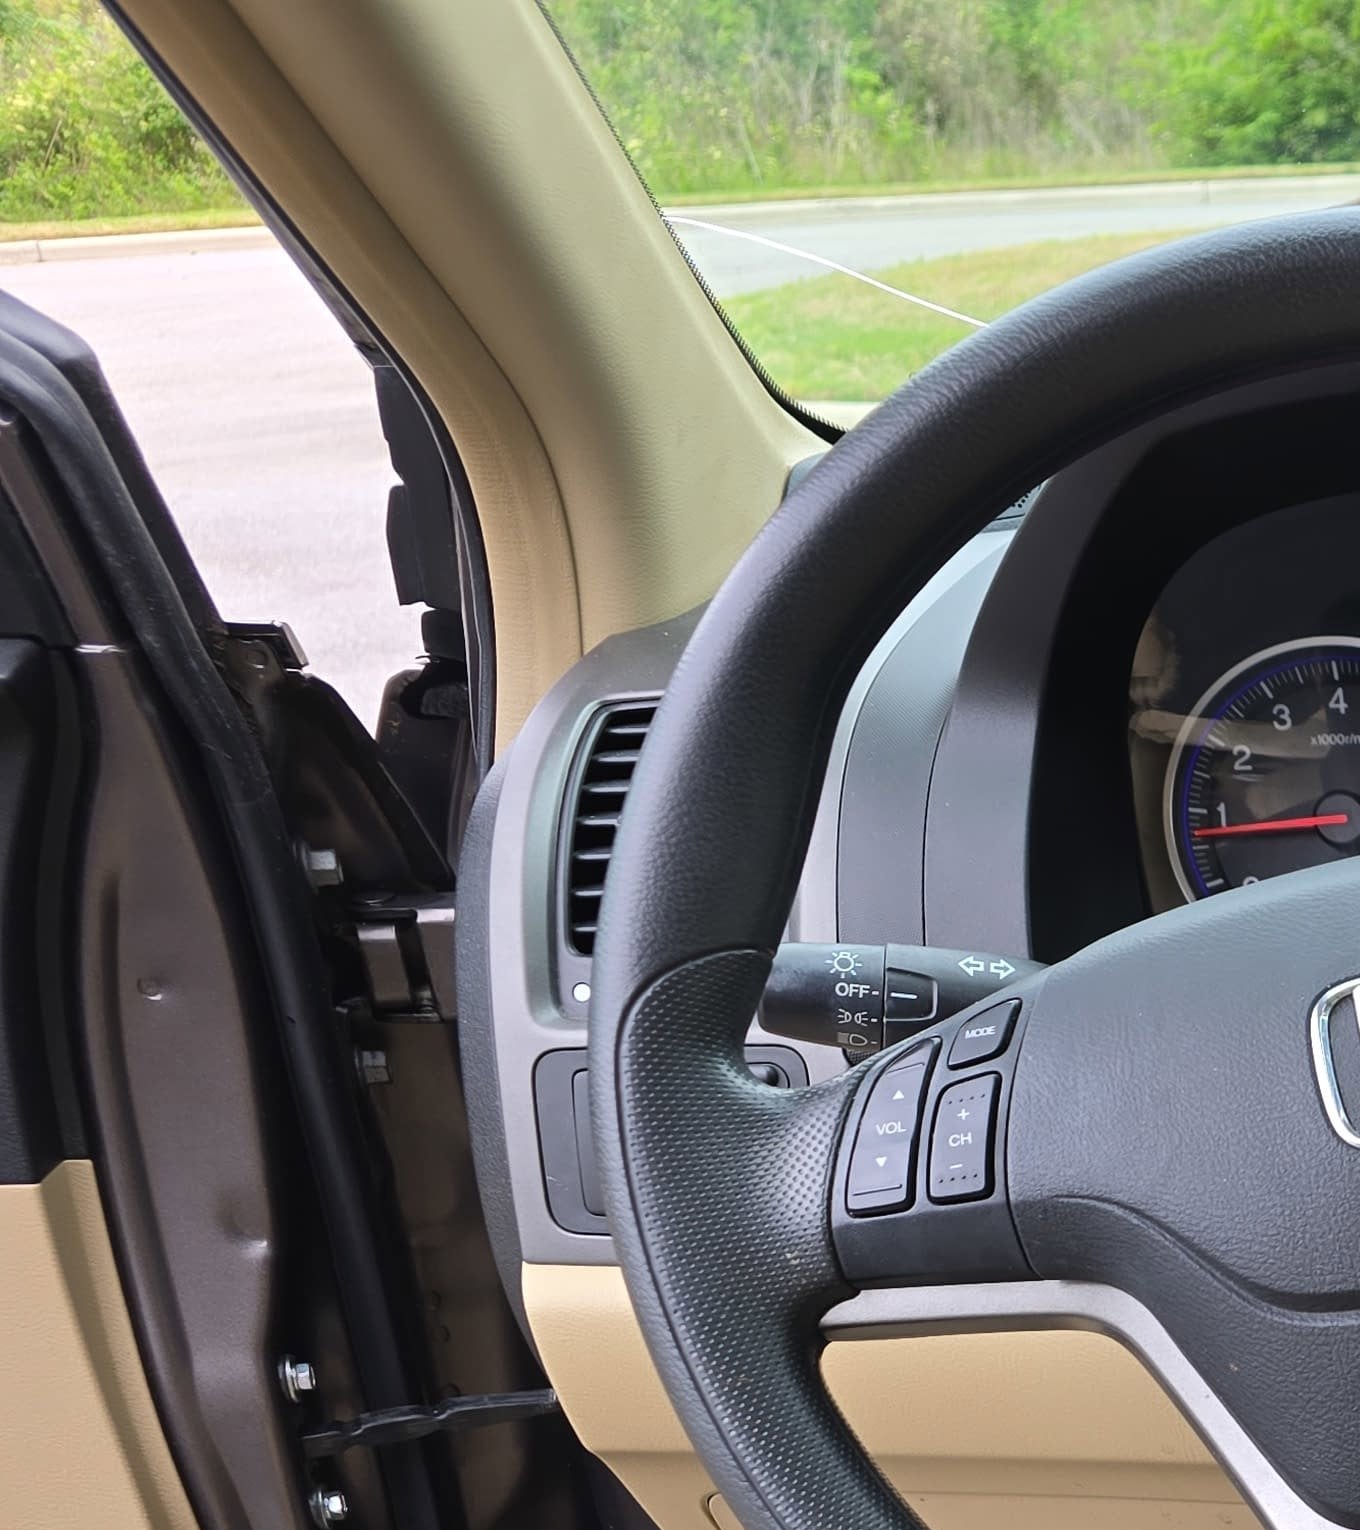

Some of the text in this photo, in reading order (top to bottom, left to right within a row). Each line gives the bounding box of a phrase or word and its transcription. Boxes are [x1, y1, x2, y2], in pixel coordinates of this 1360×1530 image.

[1329, 687, 1348, 714] 4
[1273, 703, 1292, 731] 3
[1232, 745, 1252, 771] 2
[835, 983, 870, 998] OFF
[965, 1025, 996, 1040] MODE
[876, 1121, 907, 1136] VOL
[949, 1132, 972, 1147] CH
